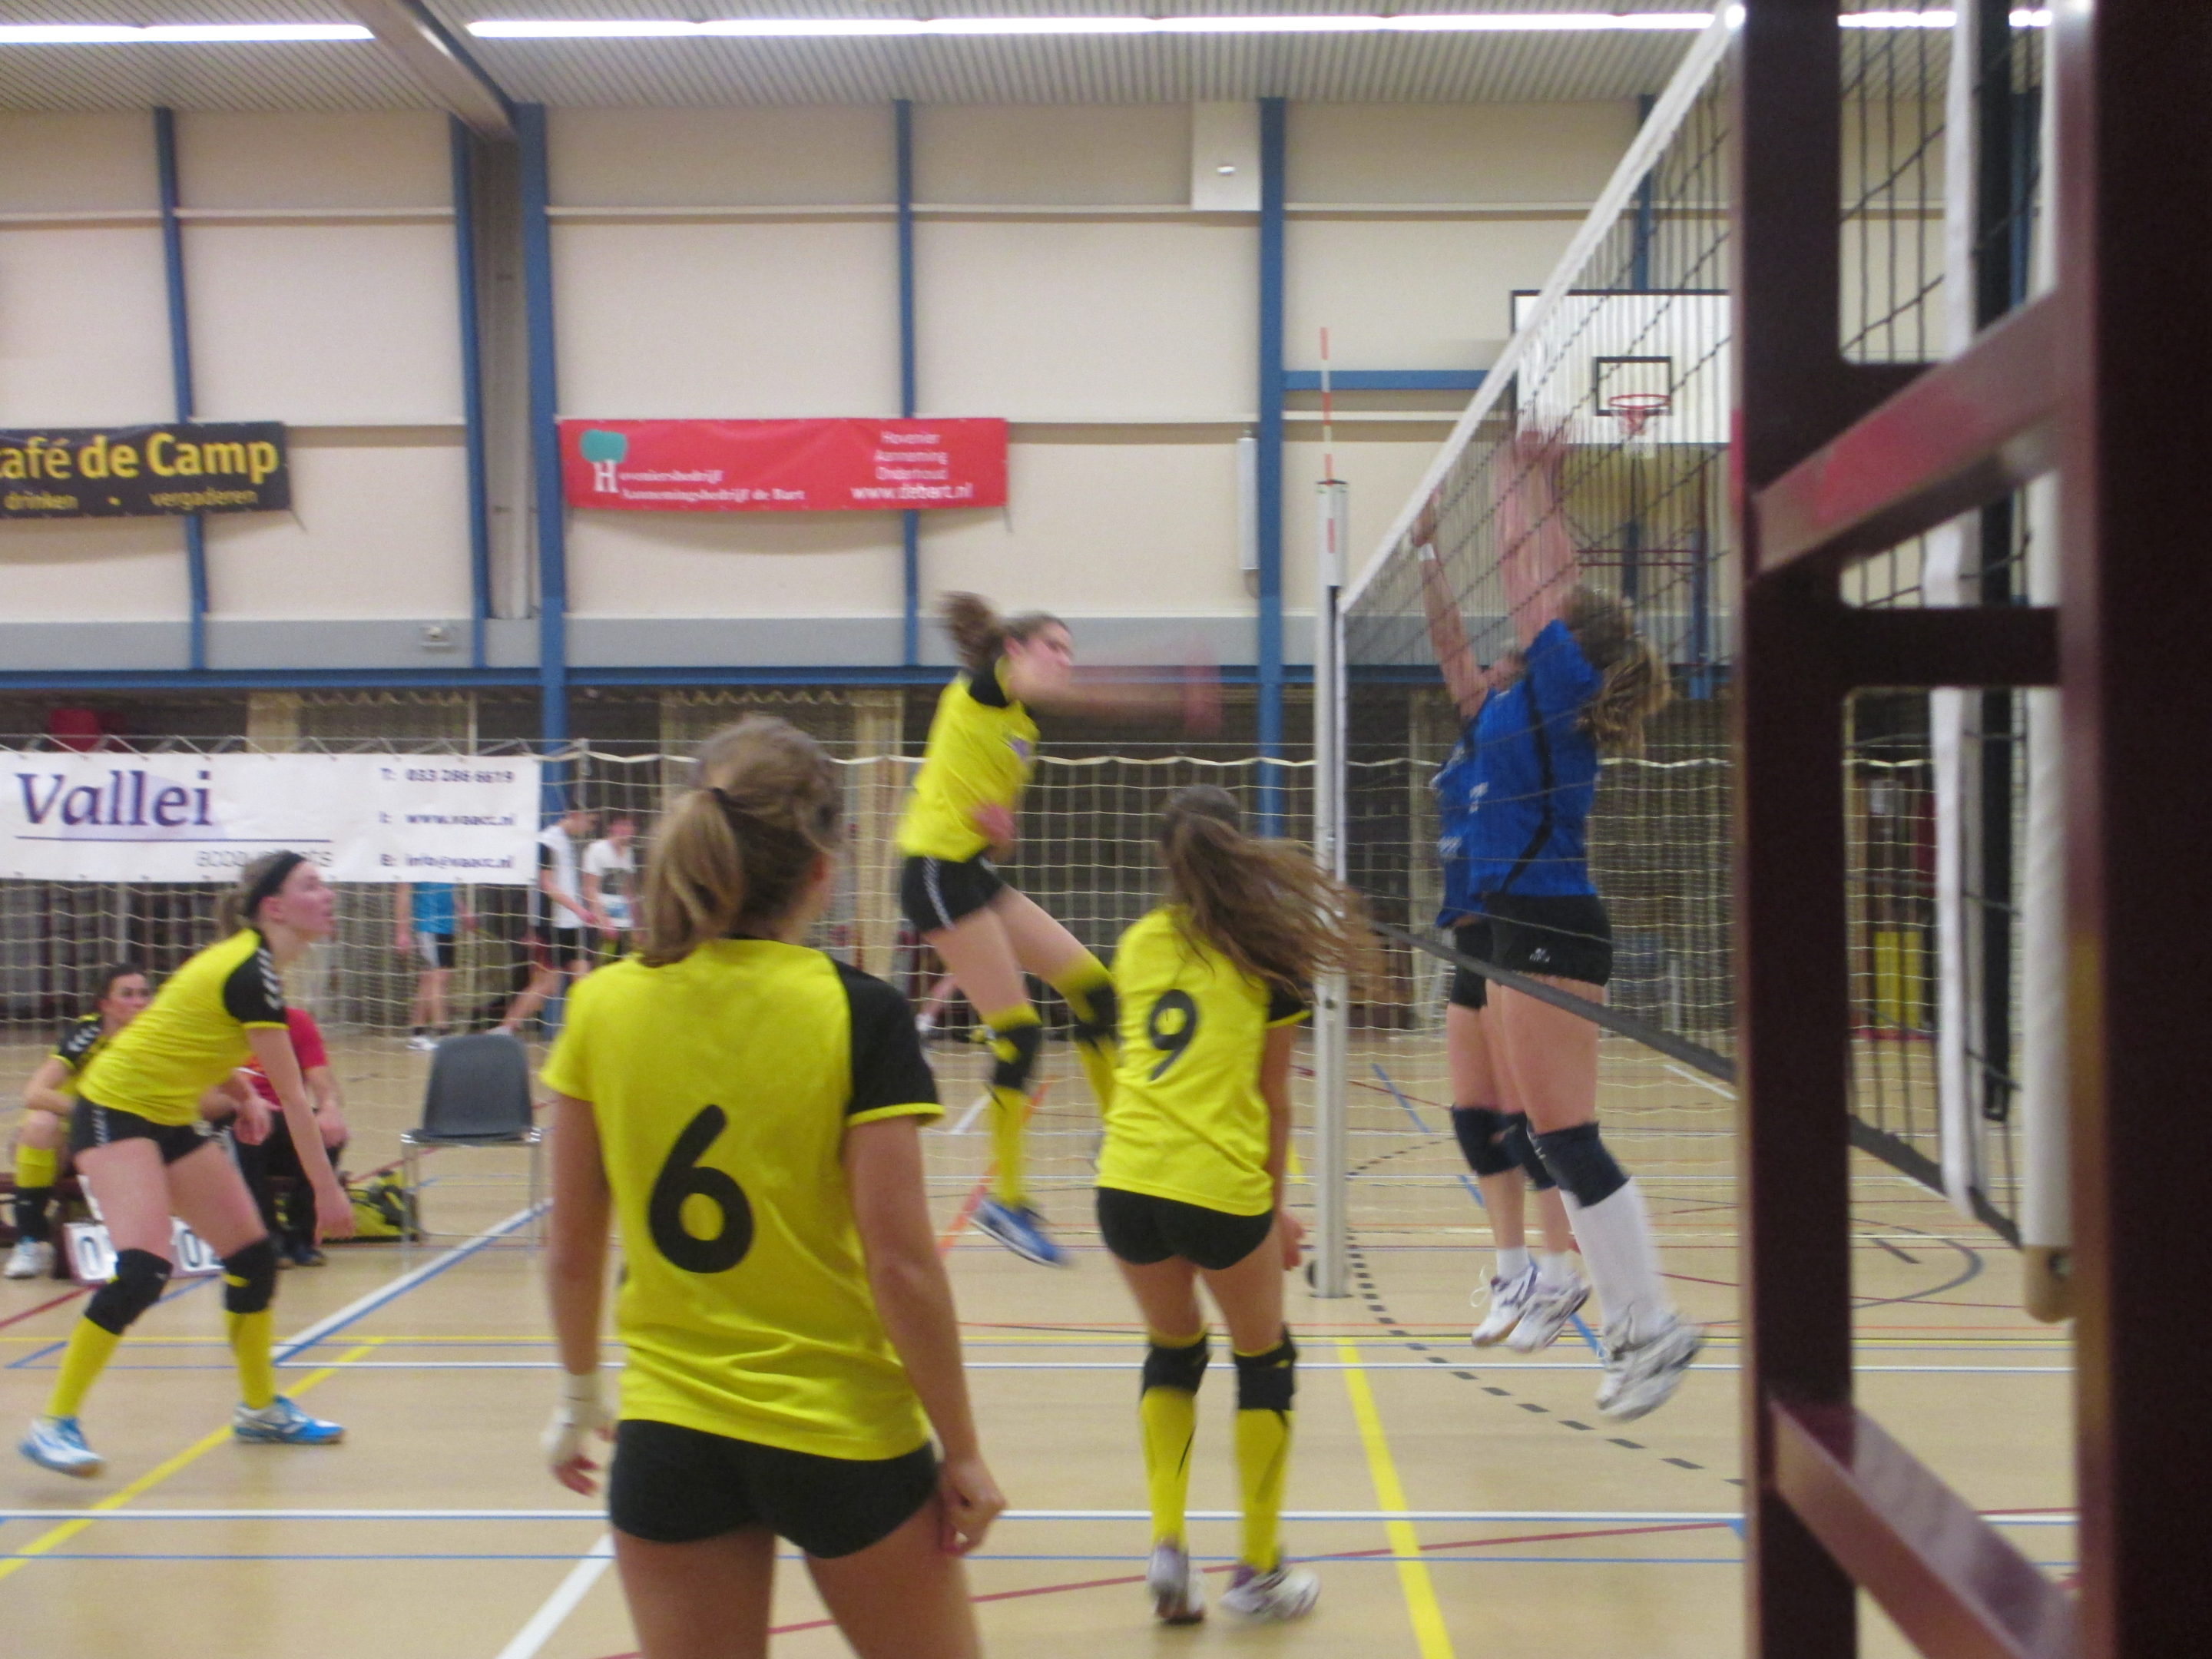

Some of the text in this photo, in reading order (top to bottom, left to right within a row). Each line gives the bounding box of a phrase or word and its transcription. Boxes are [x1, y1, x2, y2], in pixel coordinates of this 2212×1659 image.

[79, 434, 139, 478] de
[146, 432, 278, 484] Camp
[15, 770, 212, 826] Vallei
[1148, 988, 1197, 1081] 9
[648, 1104, 754, 1273] 6
